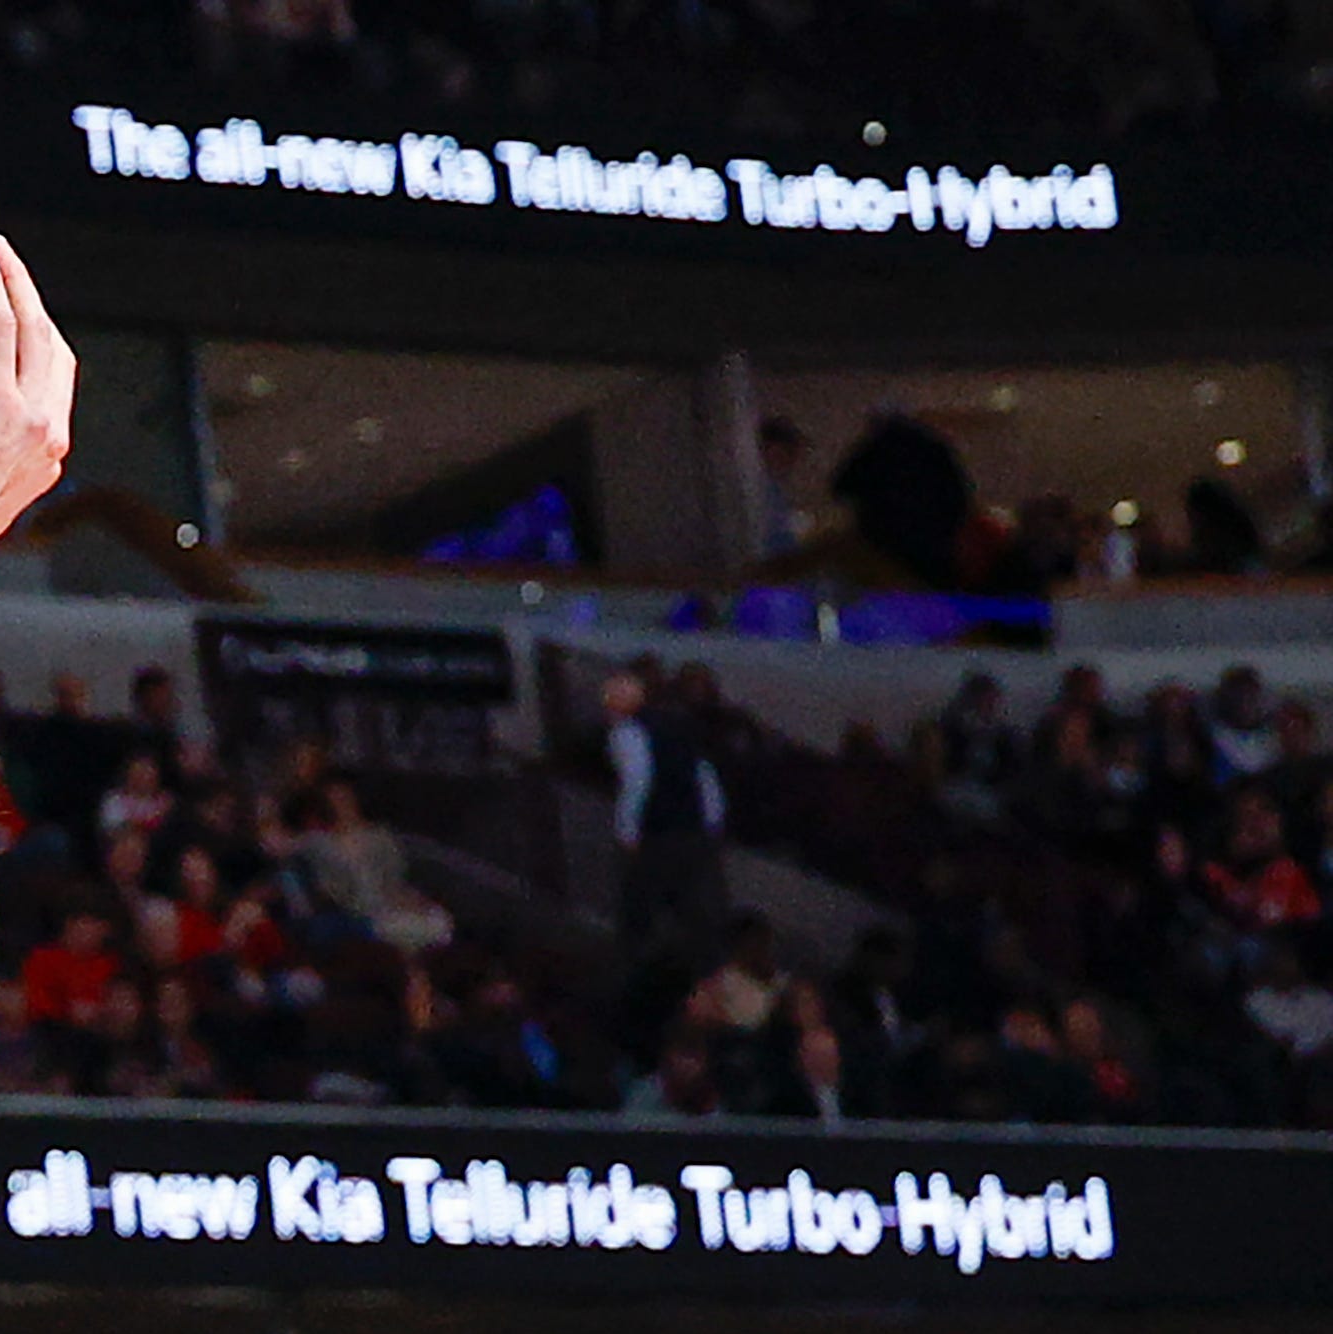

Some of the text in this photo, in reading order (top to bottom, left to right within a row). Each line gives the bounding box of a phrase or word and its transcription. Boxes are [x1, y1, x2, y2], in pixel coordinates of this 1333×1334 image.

[72, 105, 1117, 247] The all-new Kia Telluride Turbo-Hybrid
[7, 1149, 257, 1239] all-new
[268, 1155, 384, 1242] Kia
[386, 1159, 677, 1250] Telluride
[680, 1164, 1114, 1273] Turbo-Hybrid
